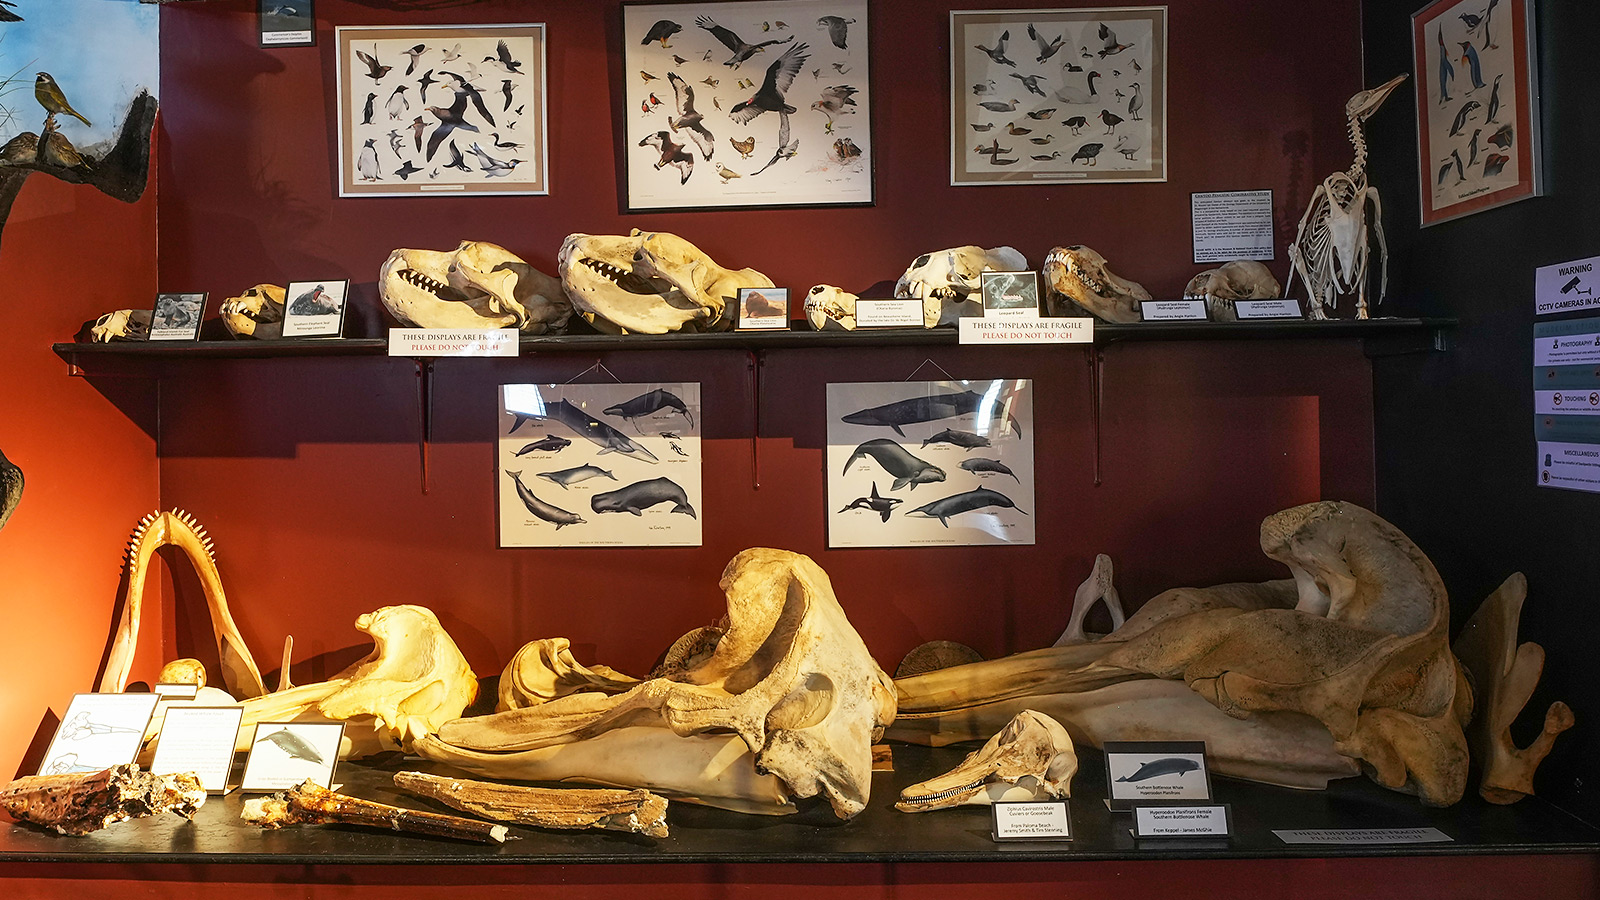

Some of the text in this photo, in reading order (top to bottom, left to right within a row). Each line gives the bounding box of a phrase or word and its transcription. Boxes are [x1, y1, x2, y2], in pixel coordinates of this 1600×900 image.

[1558, 263, 1592, 276] WARNING
[1538, 302, 1554, 311] CCTV
[1554, 298, 1584, 309] CAMERAS
[1560, 340, 1592, 348] PHOTOGRAPHY
[1564, 450, 1600, 458] MISCELLANEOUS
